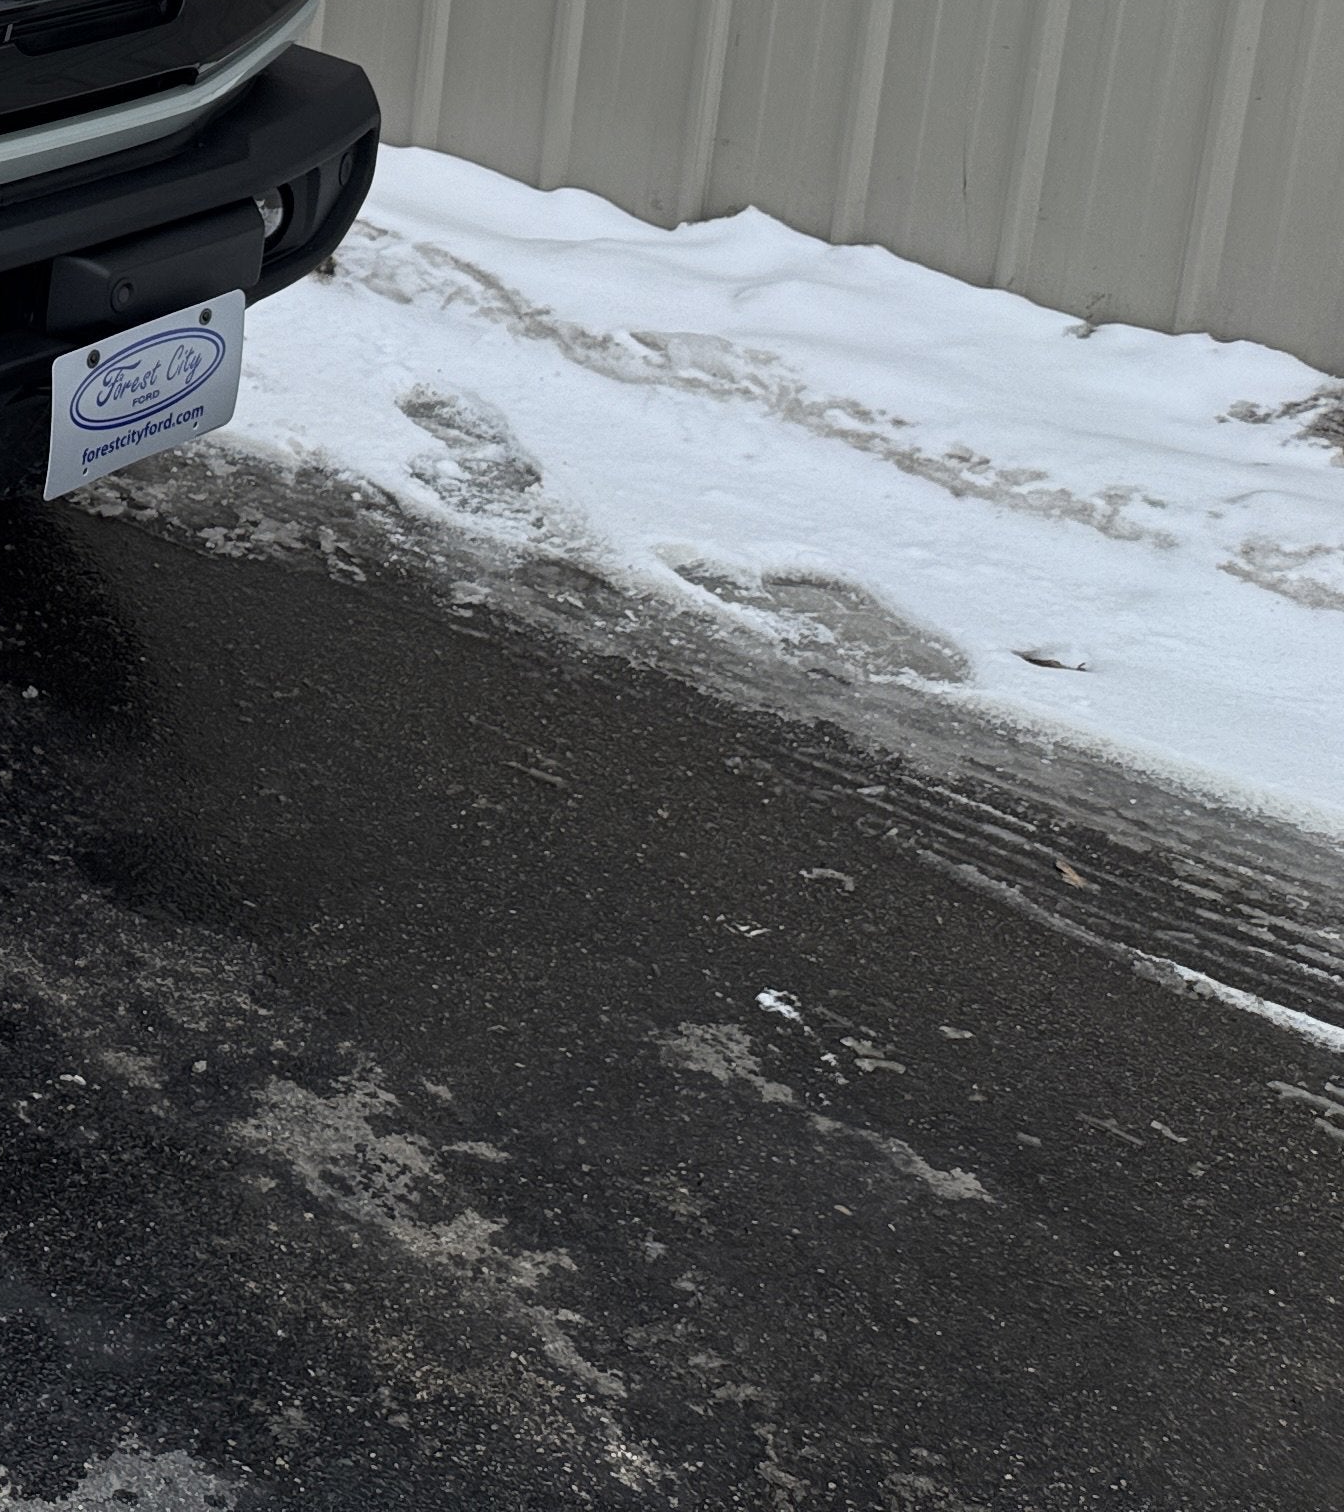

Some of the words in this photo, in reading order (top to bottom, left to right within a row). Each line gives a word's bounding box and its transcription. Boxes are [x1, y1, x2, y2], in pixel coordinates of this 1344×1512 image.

[96, 359, 162, 407] Forest
[166, 344, 203, 385] City
[132, 389, 161, 407] FORD
[82, 405, 204, 466] forestcityford.com
